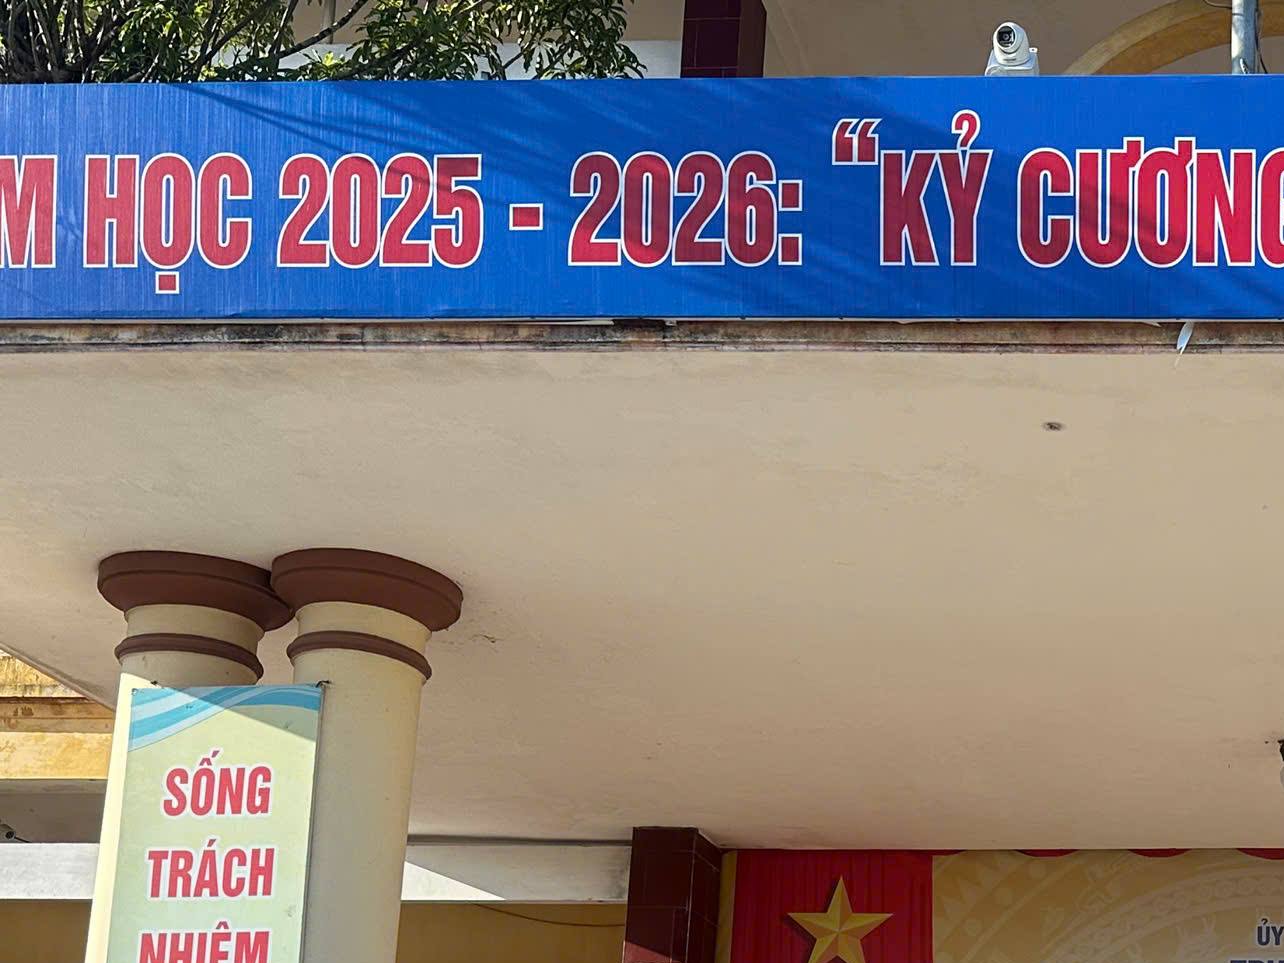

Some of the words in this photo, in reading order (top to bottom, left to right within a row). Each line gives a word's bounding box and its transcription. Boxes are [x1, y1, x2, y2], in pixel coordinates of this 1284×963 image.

[83, 152, 253, 294] HỌC
[276, 152, 484, 269] 2025
[567, 150, 804, 268] 2026:
[162, 750, 272, 818] SỐNG
[147, 838, 275, 899] TRÁCH
[1256, 917, 1284, 946] ỦY
